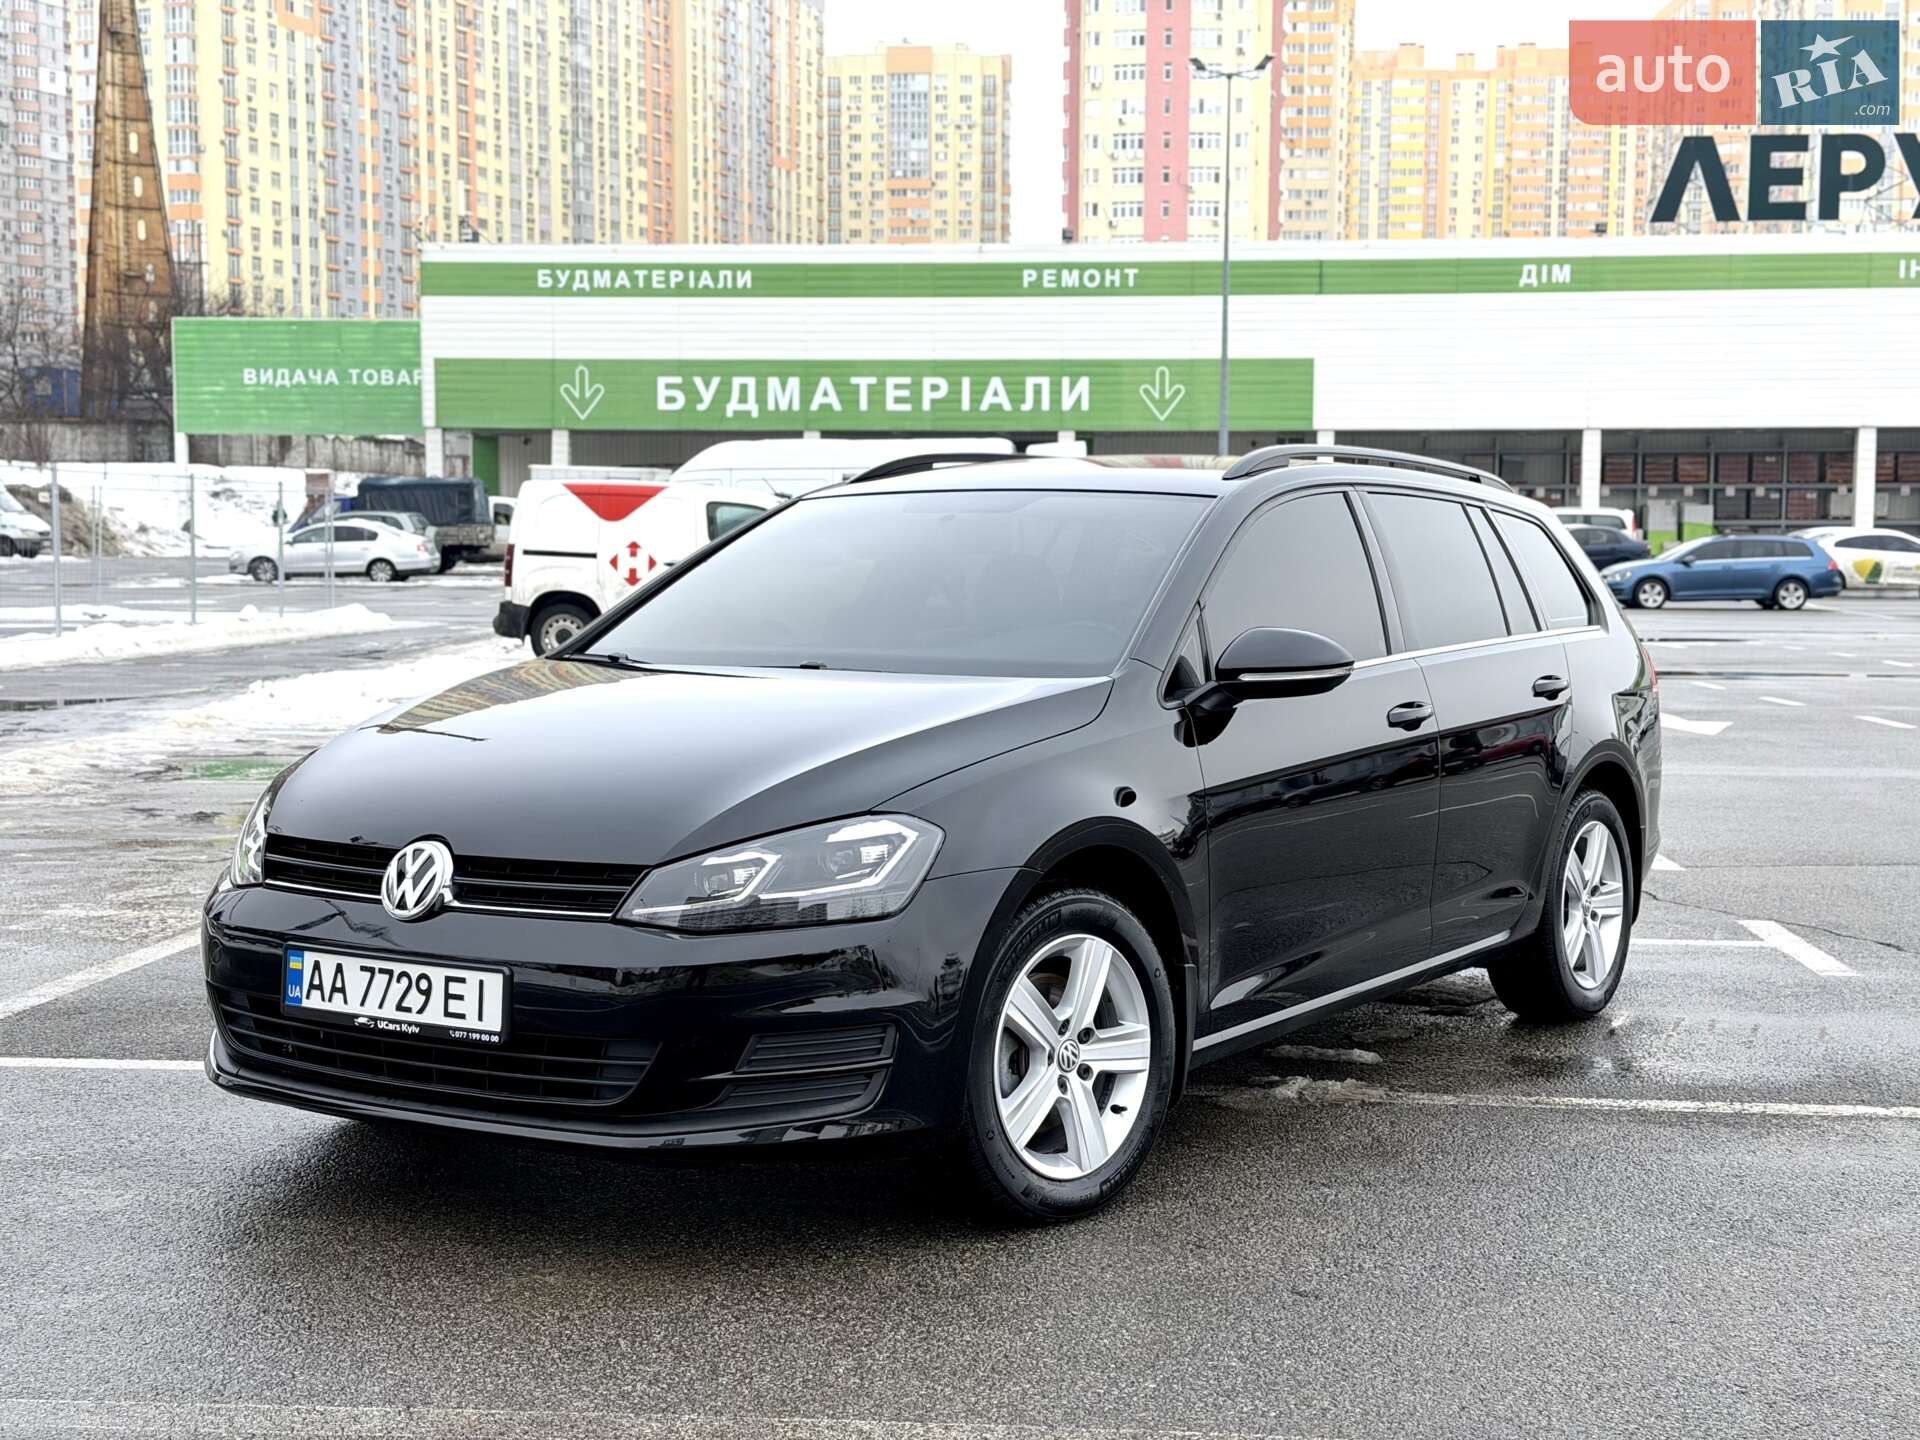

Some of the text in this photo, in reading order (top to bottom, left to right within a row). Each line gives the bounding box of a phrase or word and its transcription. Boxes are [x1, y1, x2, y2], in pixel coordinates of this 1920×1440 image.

[537, 269, 752, 292] БУДМАТЕРІАЛИ
[1022, 268, 1139, 288] РЕМОНТ
[1519, 264, 1571, 288] ДІМ
[242, 368, 339, 388] ВИДАЧА
[656, 376, 1091, 418] БУДМАТЕРІАЛИ
[288, 984, 302, 998] UA
[305, 959, 485, 1022] AA 7729 EI
[377, 1020, 421, 1034] UCars Kyiv
